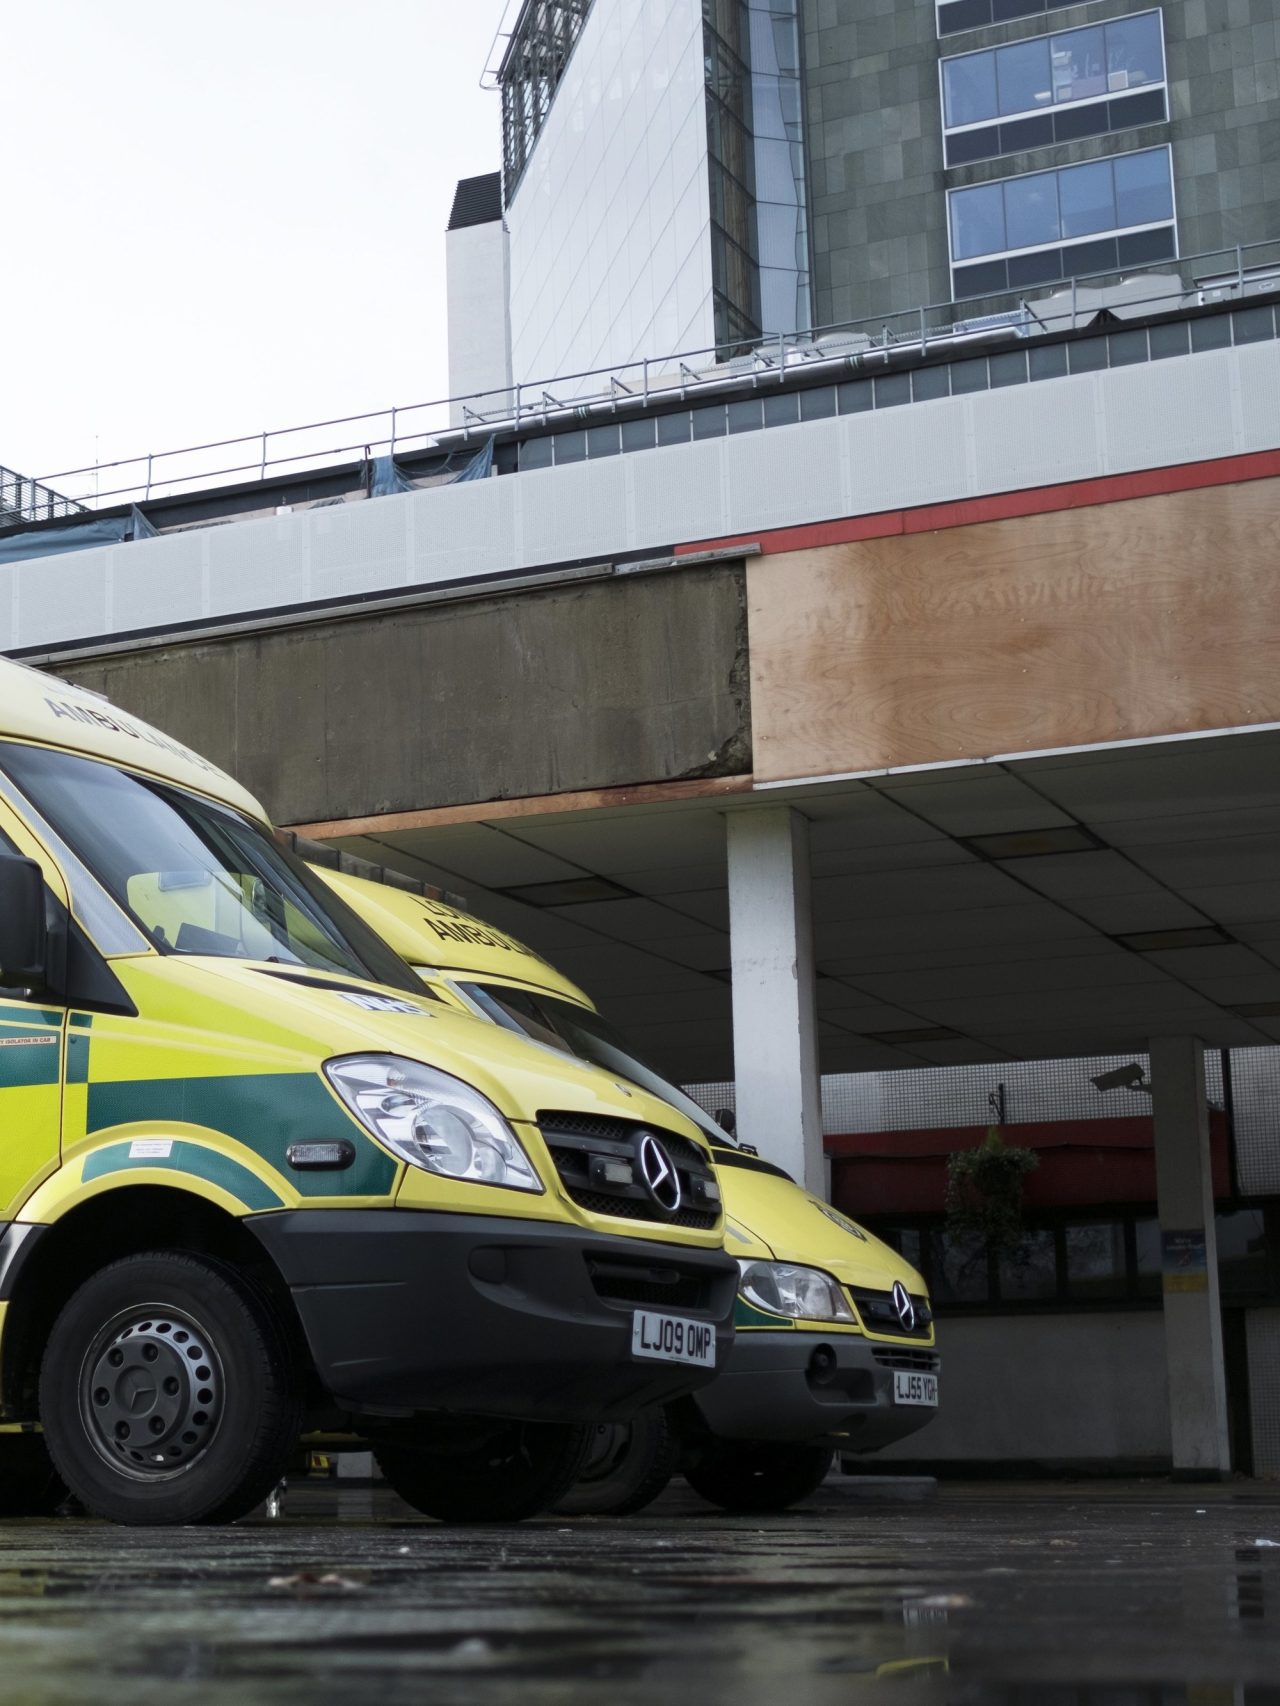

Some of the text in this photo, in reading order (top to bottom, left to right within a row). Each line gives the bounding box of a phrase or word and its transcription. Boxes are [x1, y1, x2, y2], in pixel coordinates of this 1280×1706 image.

[641, 1315, 711, 1360] LJ09 OMP
[897, 1375, 922, 1400] LJ55
